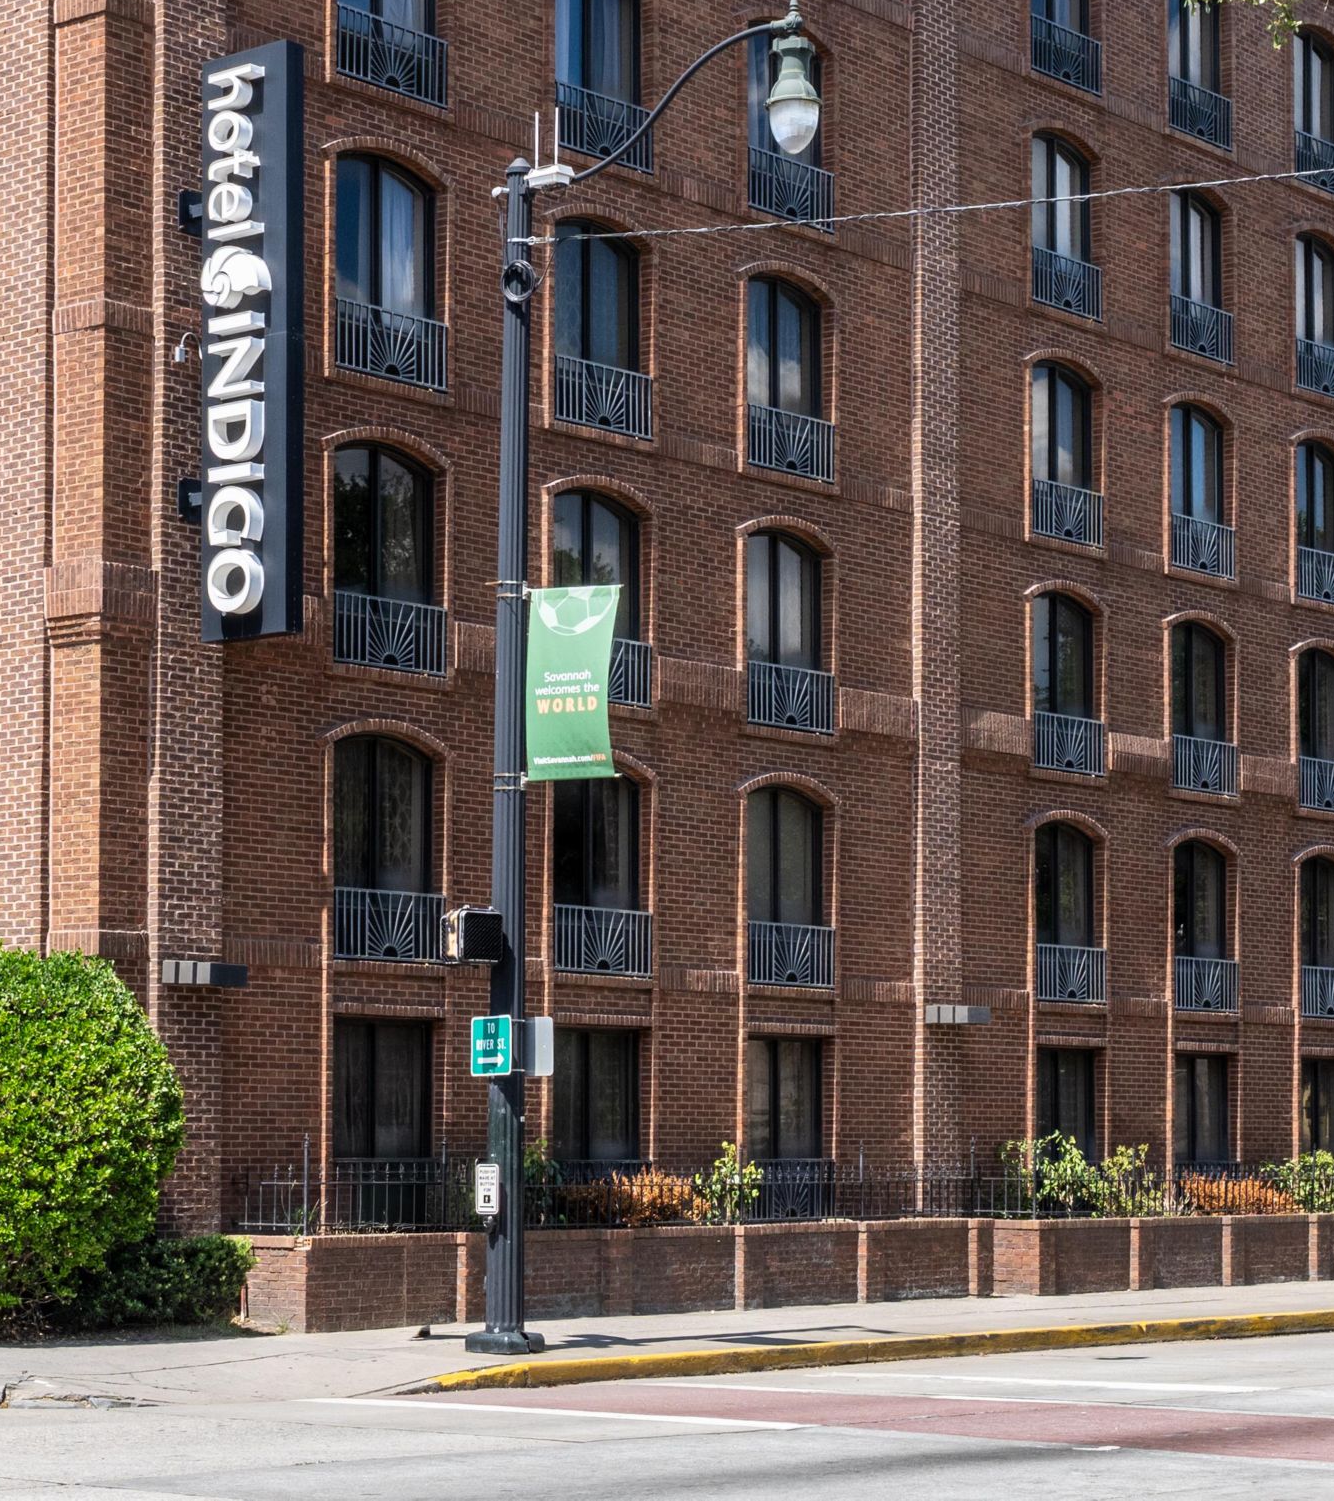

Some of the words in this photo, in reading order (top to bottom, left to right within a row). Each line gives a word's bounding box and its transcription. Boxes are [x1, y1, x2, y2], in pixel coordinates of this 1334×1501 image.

[208, 62, 265, 242] hotel
[207, 310, 265, 614] INDIGO
[544, 669, 592, 682] Savannah
[535, 685, 581, 696] welcomes
[584, 682, 600, 692] the
[536, 695, 598, 714] WORLD
[487, 1022, 496, 1034] TO
[475, 1039, 494, 1050] RIVER
